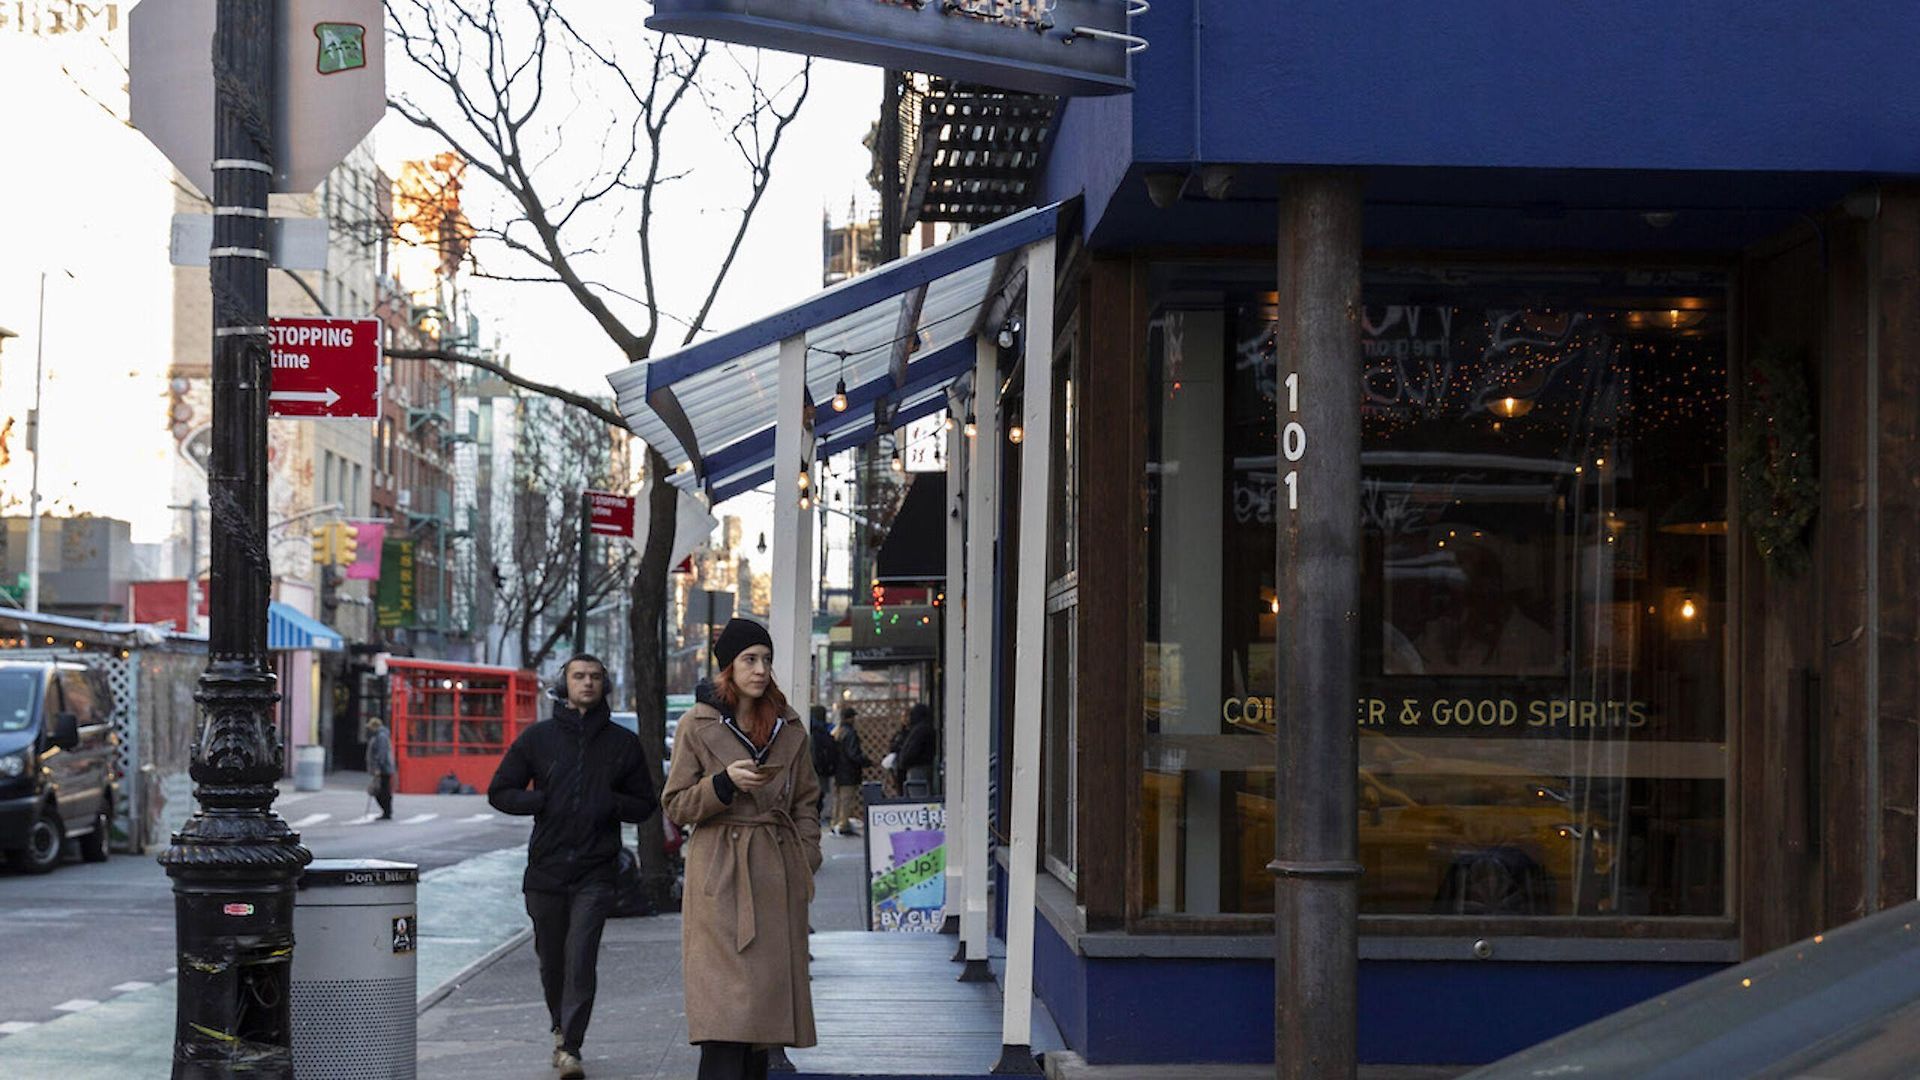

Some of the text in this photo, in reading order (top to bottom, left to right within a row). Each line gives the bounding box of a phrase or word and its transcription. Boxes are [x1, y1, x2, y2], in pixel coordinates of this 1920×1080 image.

[267, 326, 353, 347] STOPPING
[270, 349, 310, 369] time
[1283, 372, 1306, 510] 101
[595, 495, 627, 508] STOPPING
[1223, 697, 1646, 728] COL ER & GOOD SPIRITS
[872, 810, 946, 826] POWERE
[344, 871, 381, 883] Don't
[881, 909, 945, 926] BY CLE
